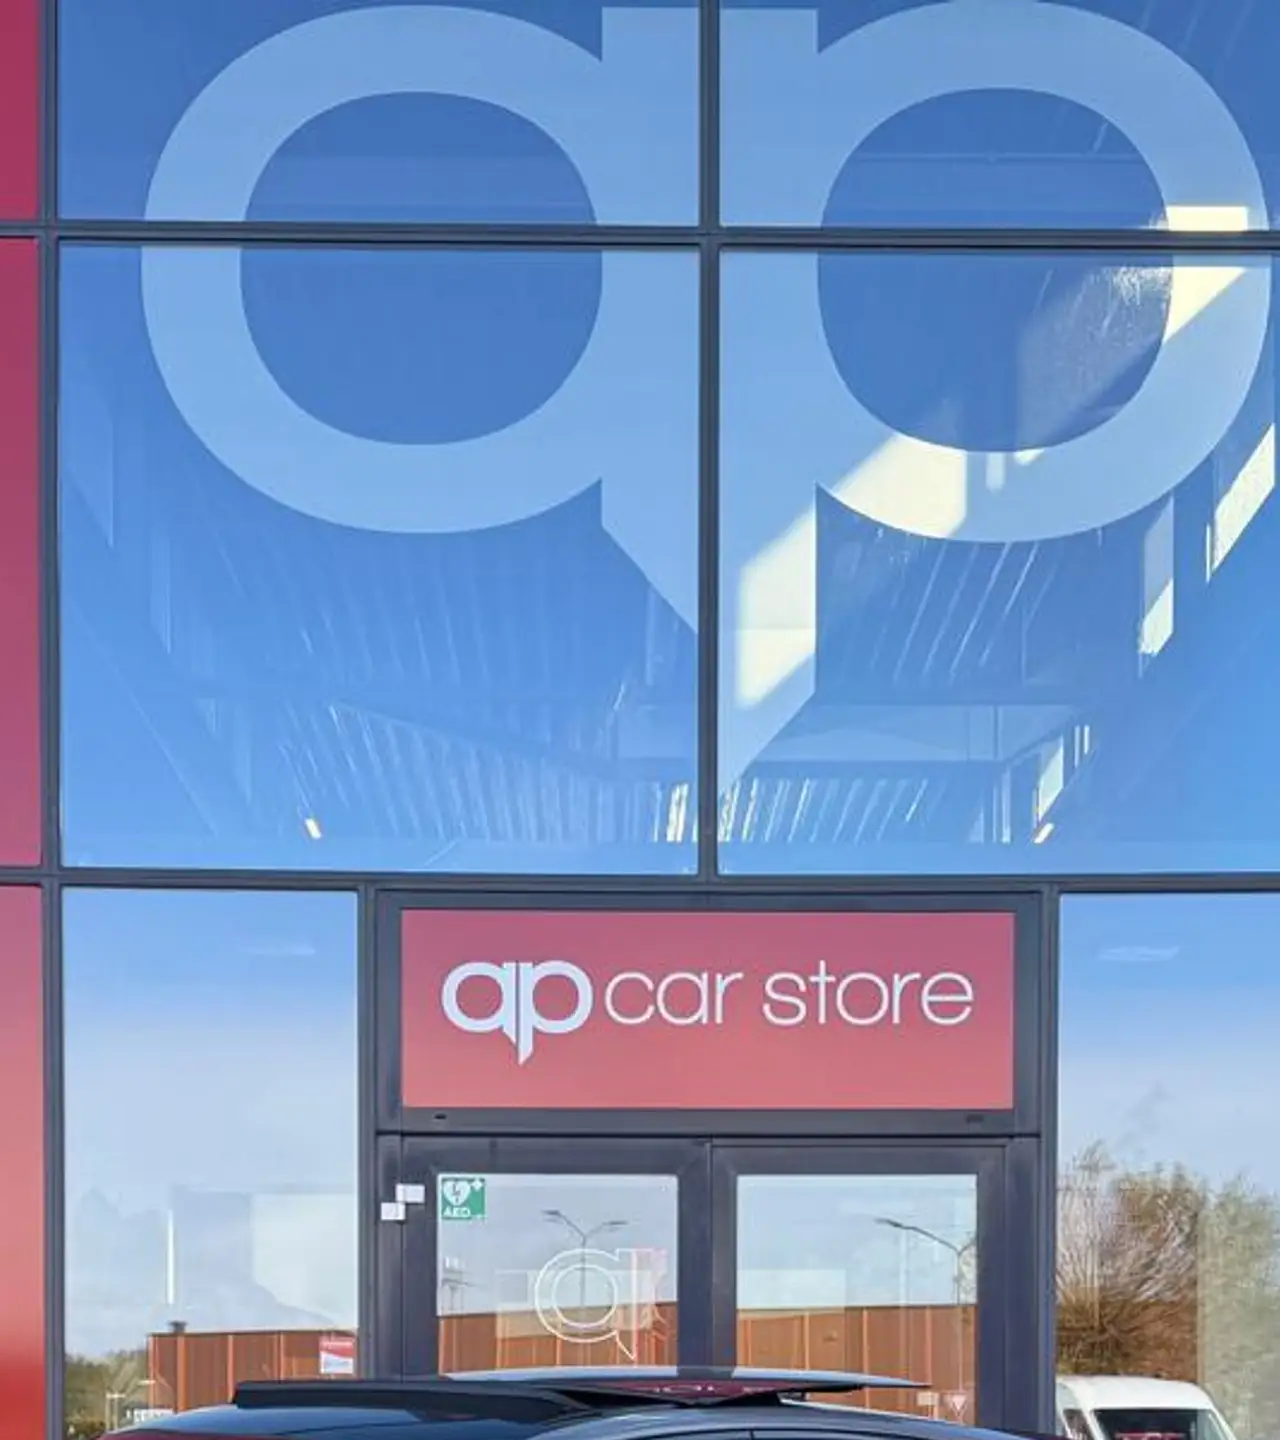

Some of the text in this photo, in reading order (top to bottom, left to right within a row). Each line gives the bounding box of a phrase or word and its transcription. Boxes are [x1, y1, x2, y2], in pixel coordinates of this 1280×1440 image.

[441, 960, 974, 1066] ap car store
[443, 1207, 471, 1217] AED
